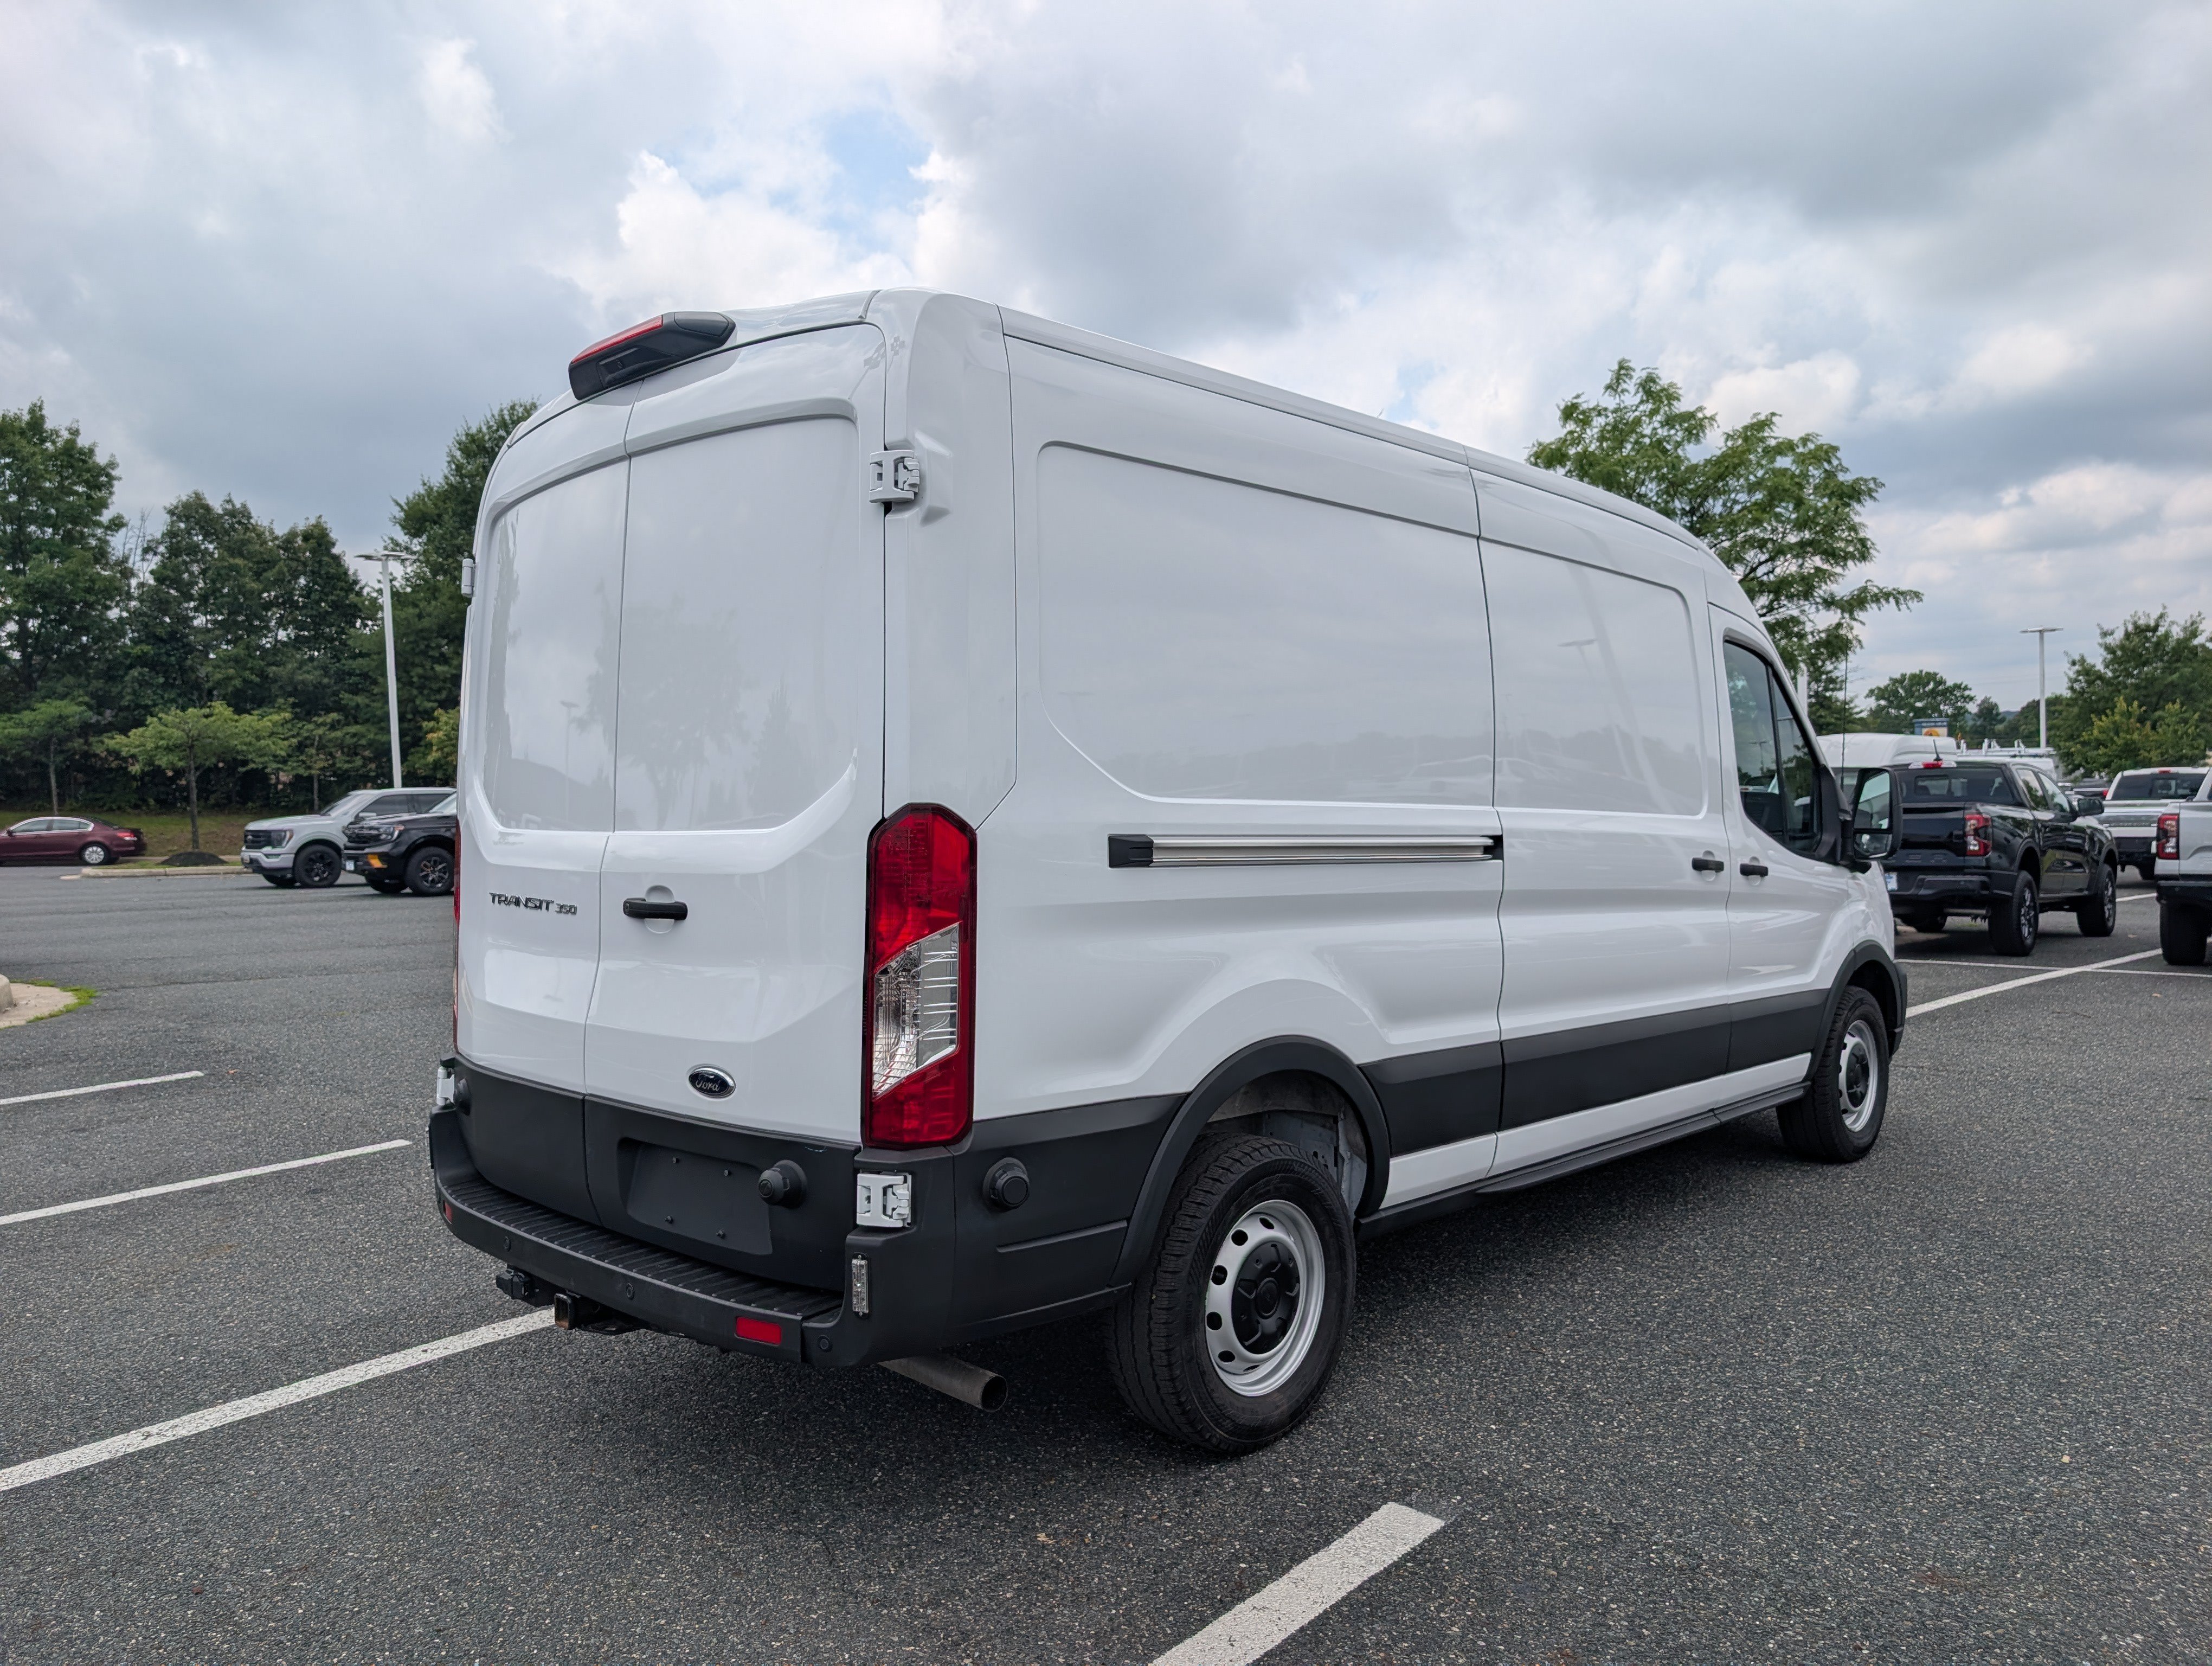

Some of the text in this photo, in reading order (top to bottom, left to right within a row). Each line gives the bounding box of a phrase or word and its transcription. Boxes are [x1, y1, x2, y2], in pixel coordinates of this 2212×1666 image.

[489, 892, 577, 915] TRANSIT 350
[696, 1073, 721, 1091] Ford
